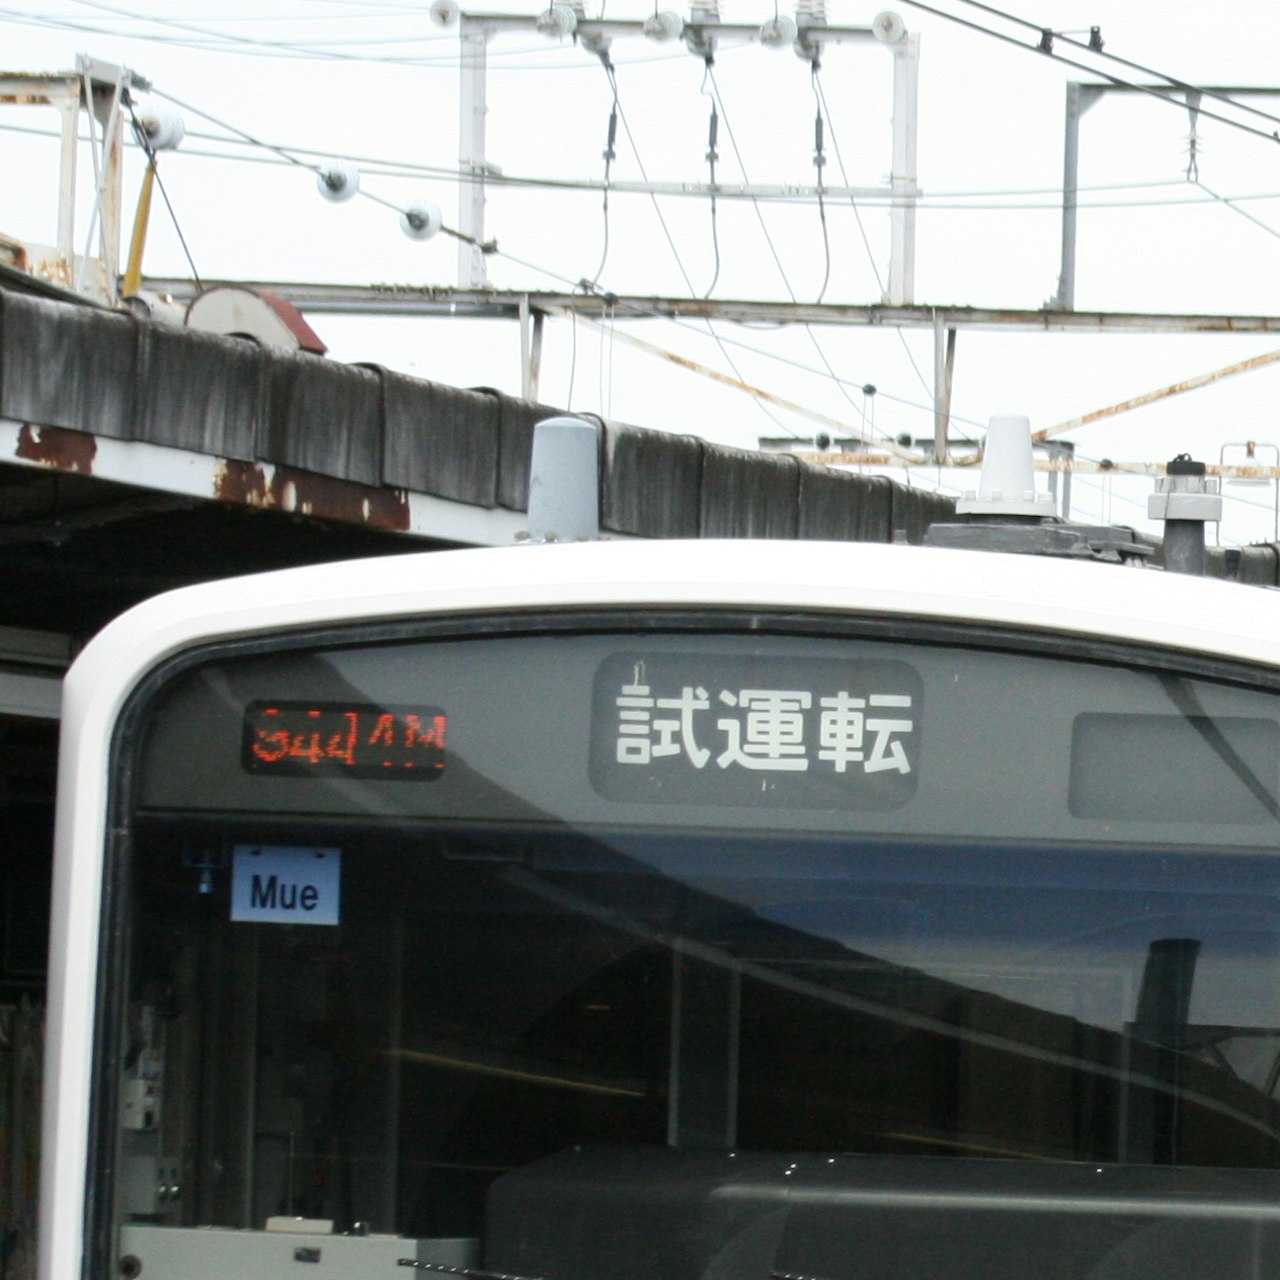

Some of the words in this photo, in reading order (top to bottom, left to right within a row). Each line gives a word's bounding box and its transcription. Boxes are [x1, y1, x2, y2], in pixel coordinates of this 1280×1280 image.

[616, 686, 913, 774] 試運転
[250, 874, 320, 912] Mue
